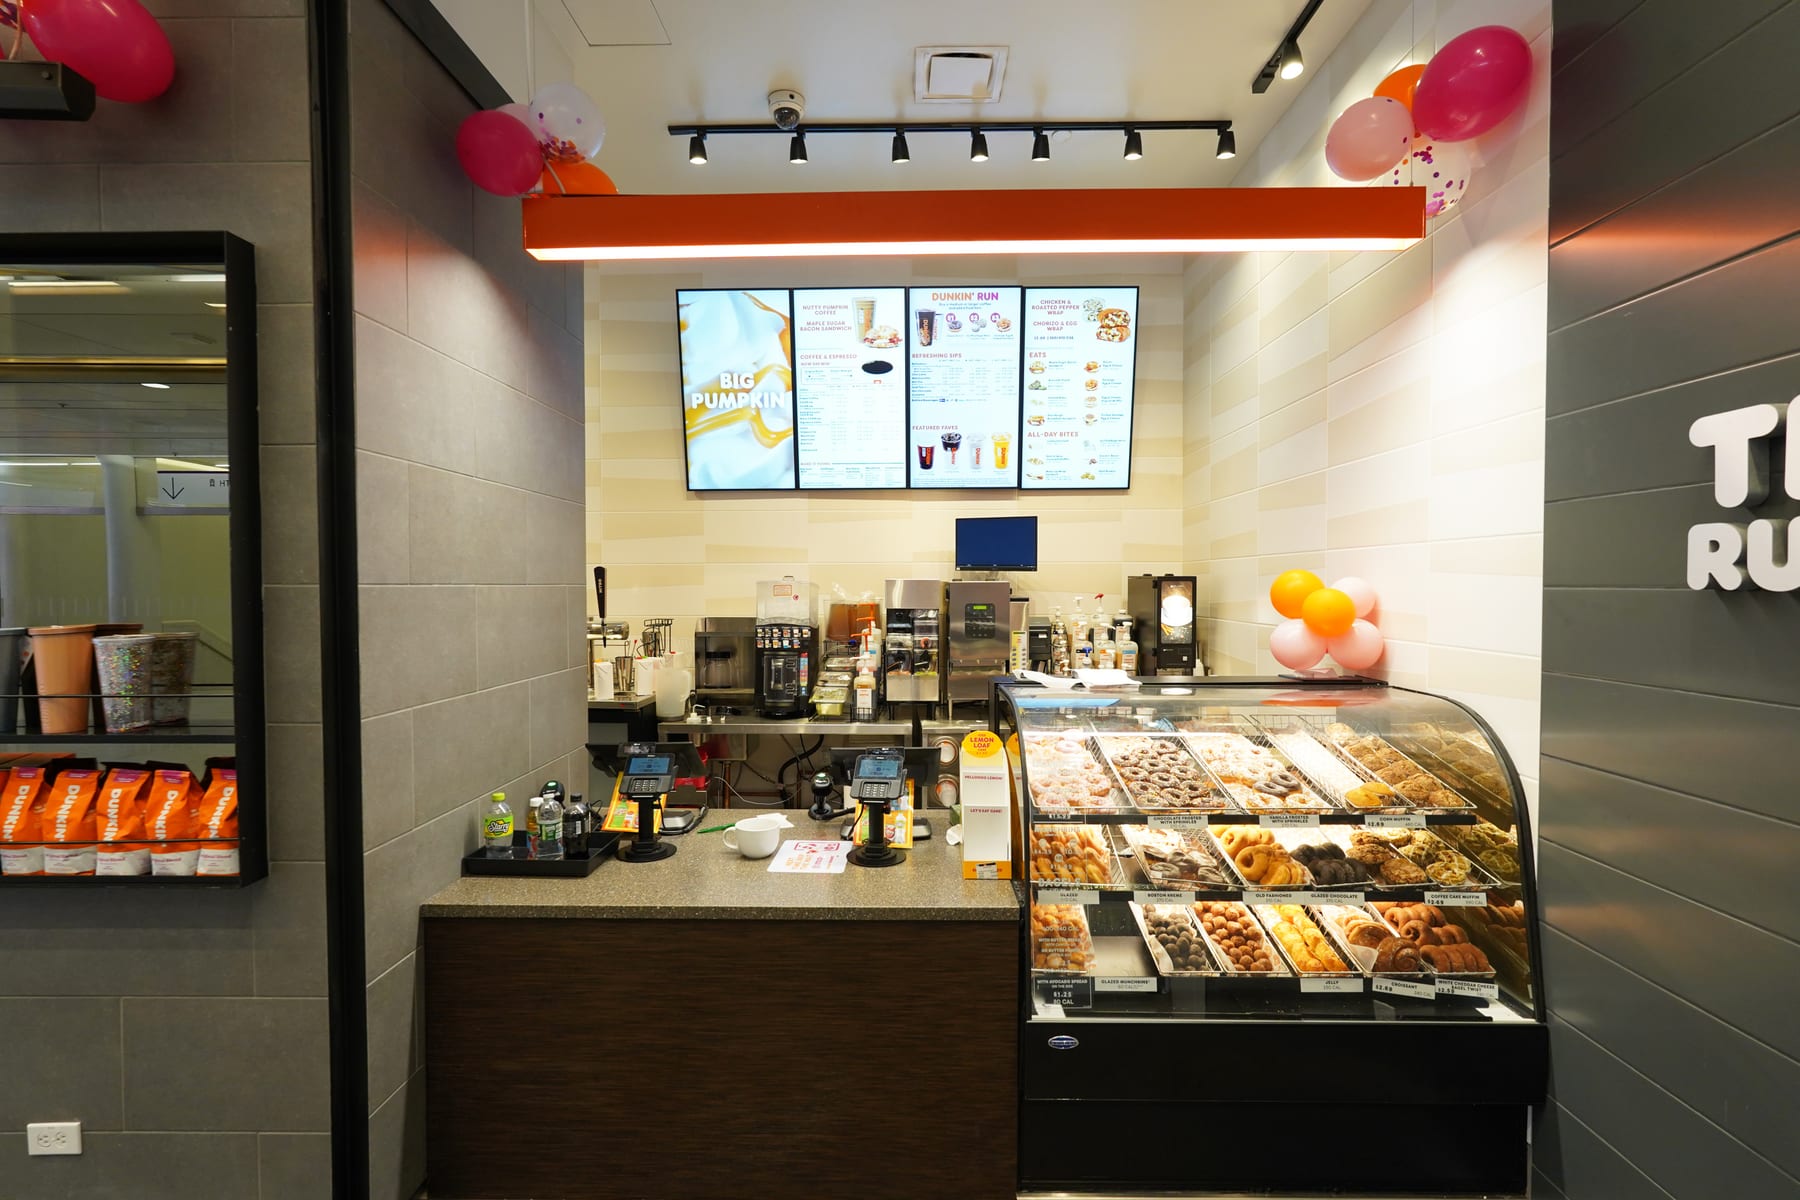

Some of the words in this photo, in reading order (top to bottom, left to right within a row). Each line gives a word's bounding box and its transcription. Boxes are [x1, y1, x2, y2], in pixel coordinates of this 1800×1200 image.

[932, 292, 974, 301] DUNKIN'
[977, 292, 999, 301] RUN
[719, 372, 755, 390] BIG
[691, 391, 785, 410] PUMPKIN
[1689, 393, 1800, 508] T
[1038, 878, 1080, 887] BAGELS
